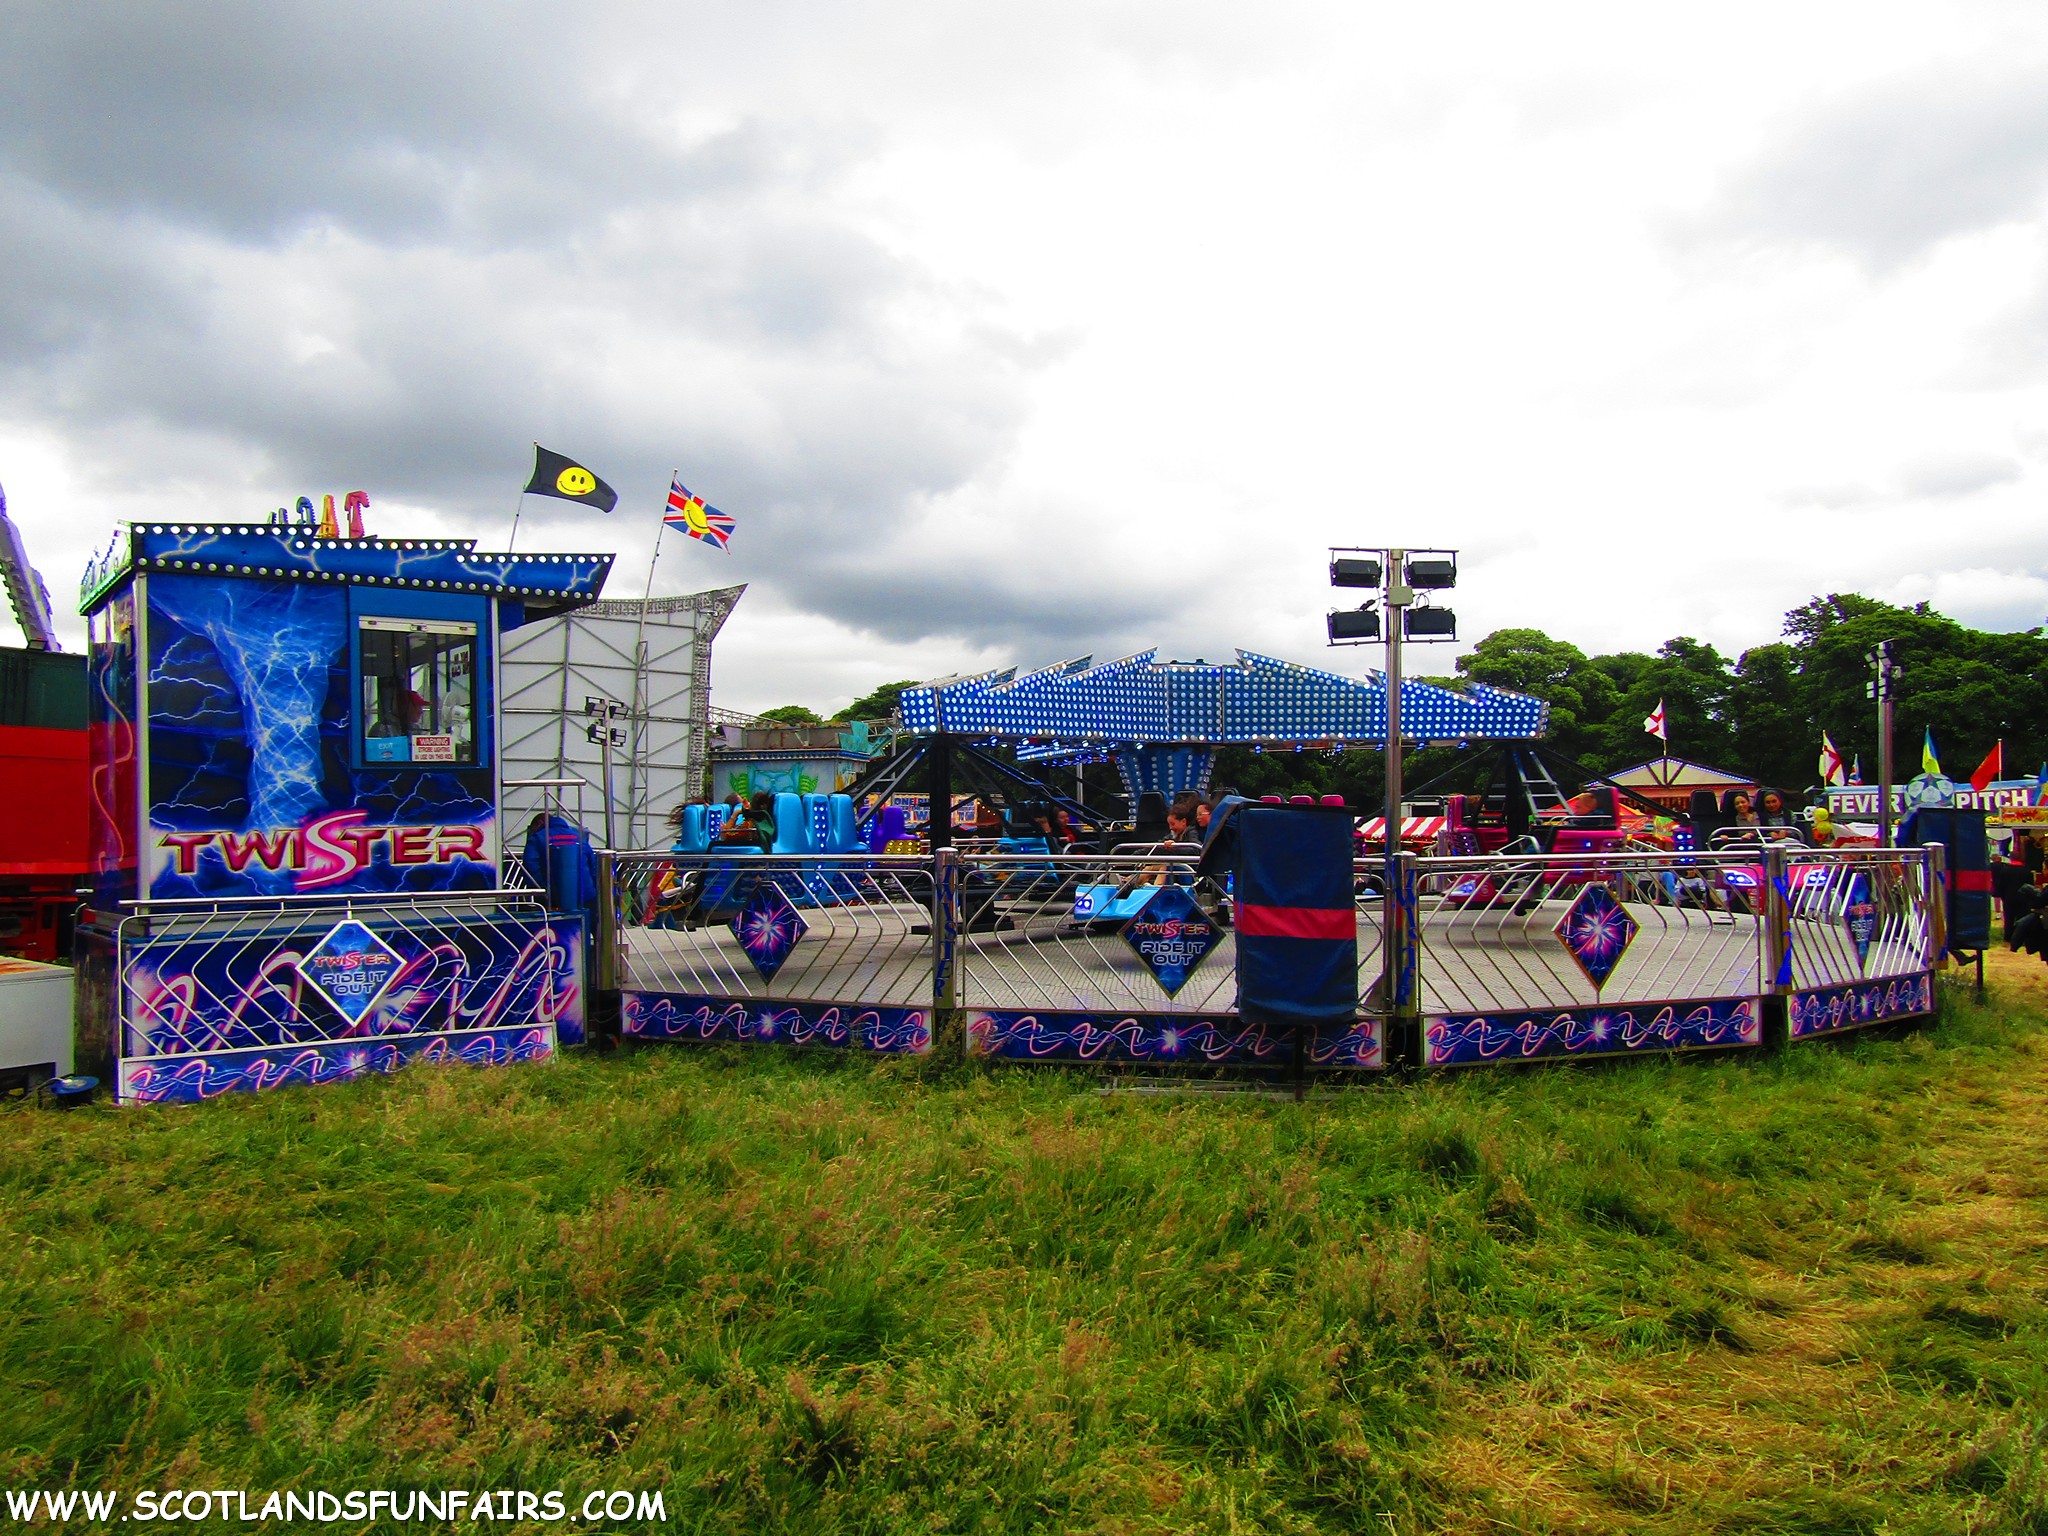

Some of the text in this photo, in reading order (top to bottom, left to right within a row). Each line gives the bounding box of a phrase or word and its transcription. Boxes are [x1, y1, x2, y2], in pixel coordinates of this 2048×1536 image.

[419, 738, 448, 746] WARNING
[1828, 789, 2029, 814] FEVER PITCH
[157, 811, 489, 891] TWISTER
[1133, 919, 1211, 938] TWISTER
[1140, 942, 1206, 953] RIDE IT
[313, 950, 391, 970] TWISTER
[1153, 954, 1194, 966] OUT
[321, 970, 387, 985] RIDE IT
[334, 984, 375, 996] OUT
